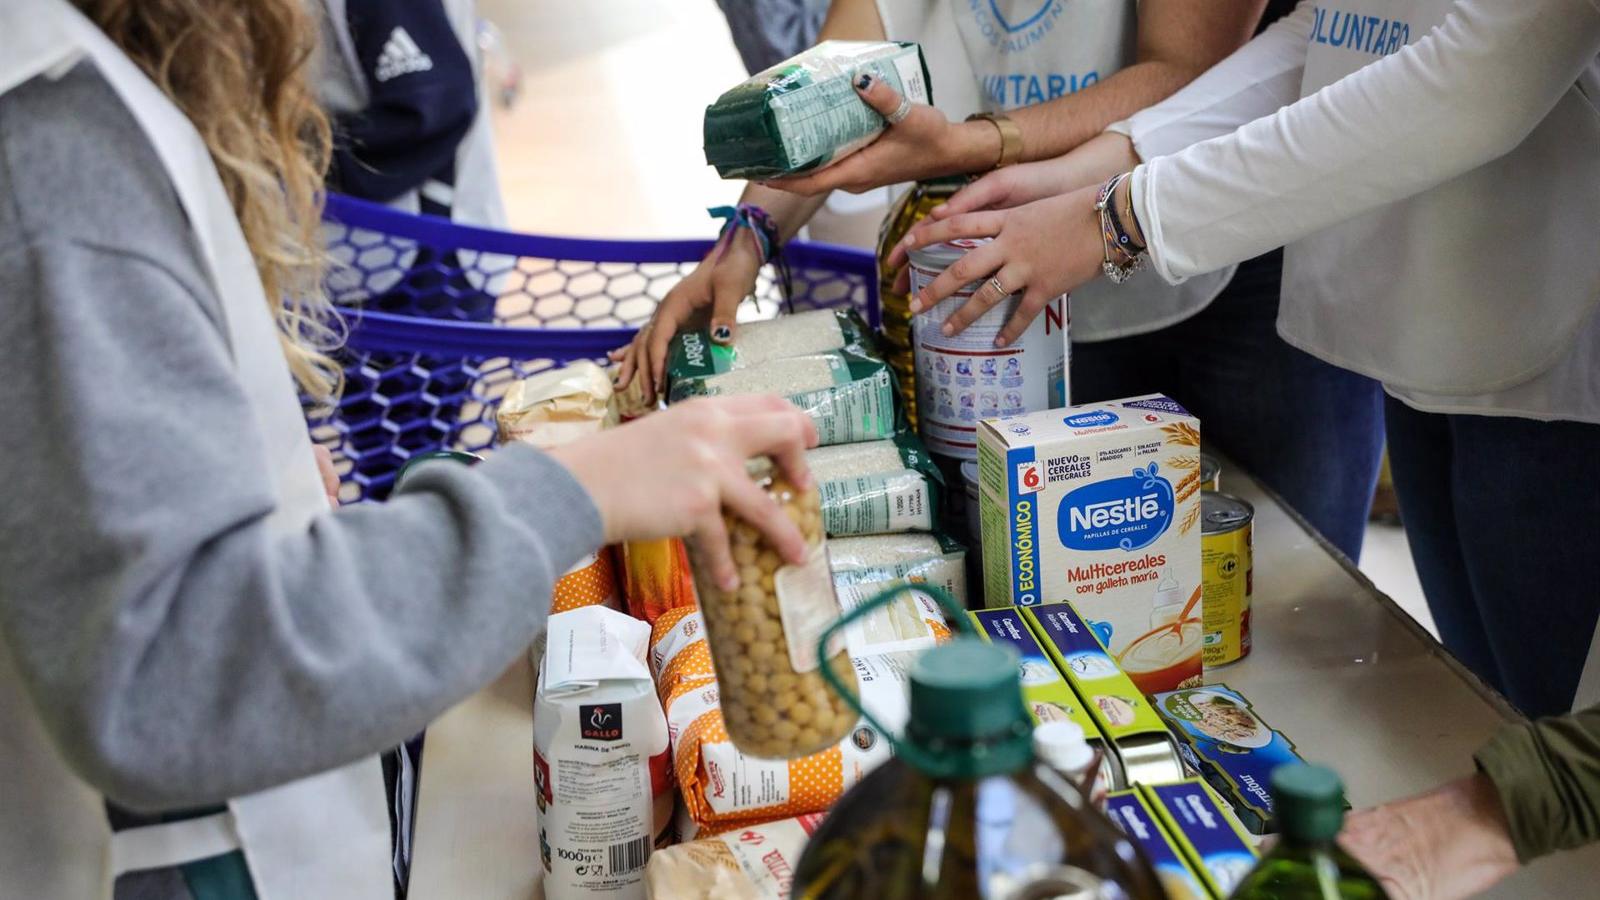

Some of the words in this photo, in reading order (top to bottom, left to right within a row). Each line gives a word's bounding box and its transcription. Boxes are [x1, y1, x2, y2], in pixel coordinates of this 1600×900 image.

[682, 333, 706, 367] ARROZ
[1047, 455, 1079, 467] NUEVO
[1048, 462, 1091, 475] CEREALES
[1023, 467, 1040, 488] 6
[1048, 470, 1092, 483] INTEGRALES
[1070, 493, 1159, 532] Nestlé
[1084, 530, 1111, 540] PAPILLAS
[1120, 523, 1148, 534] CEREALES
[1016, 501, 1035, 592] ECONÓMICO
[1067, 554, 1166, 583] Multicereales
[1076, 582, 1094, 595] con
[1096, 576, 1130, 595] galleta
[1131, 570, 1159, 585] maría
[1002, 618, 1021, 640] Carrefour
[1057, 611, 1080, 634] Carrefour
[584, 729, 619, 738] GALLO
[574, 744, 599, 752] HARINA
